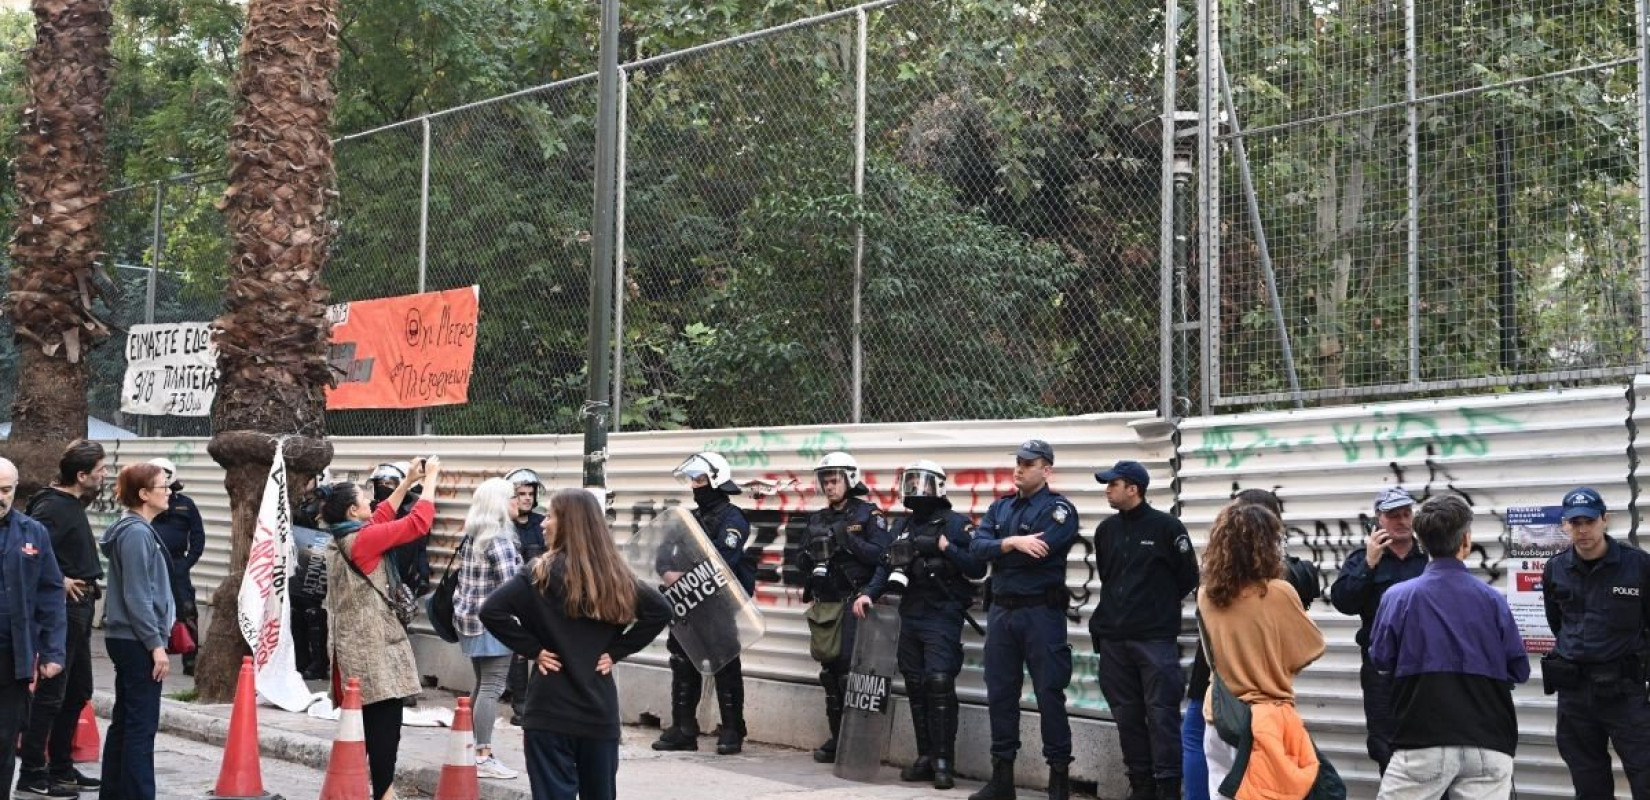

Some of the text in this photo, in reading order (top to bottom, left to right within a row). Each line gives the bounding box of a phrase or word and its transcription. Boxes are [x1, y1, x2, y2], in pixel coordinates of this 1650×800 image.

[130, 329, 180, 360] ΕΙΜΑΣΤΕ
[163, 364, 217, 393] ΠΛΑΤΕΙΑ
[1522, 561, 1545, 570] 8 Νο
[664, 561, 722, 604] ΤΥΝΟΜΙΑ
[674, 572, 728, 617] OLICE
[1612, 586, 1640, 596] POLICE
[844, 690, 881, 712] OLICE
